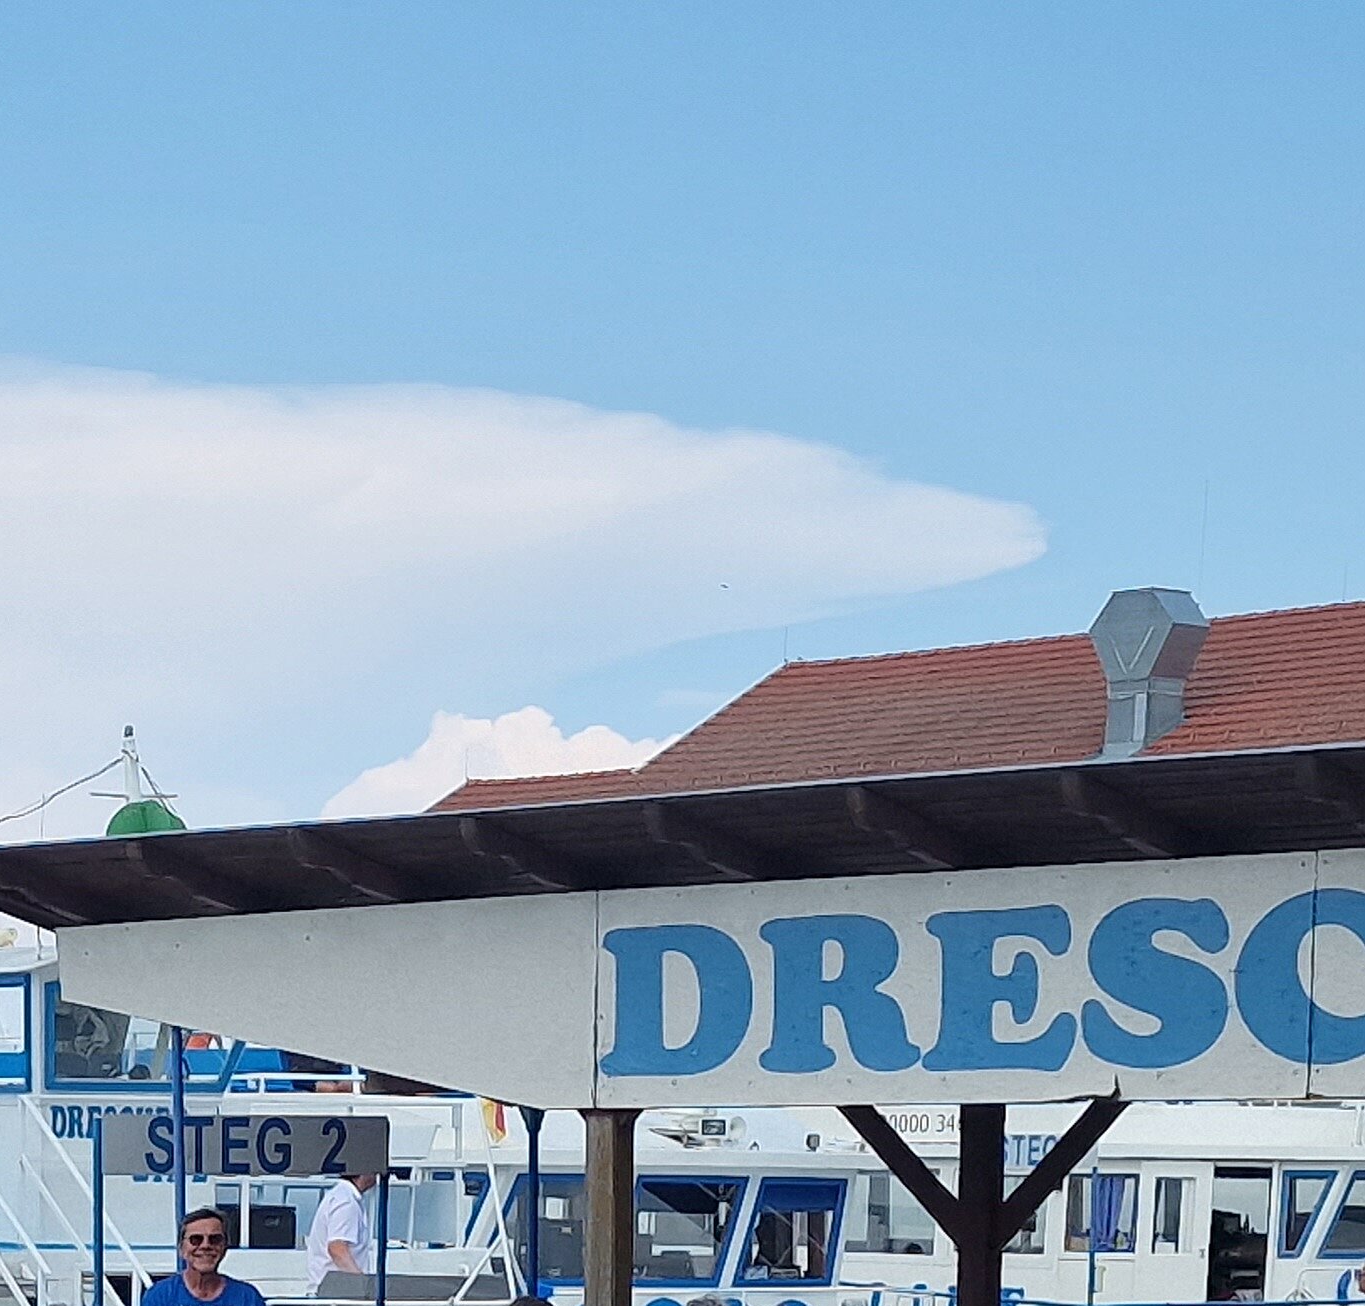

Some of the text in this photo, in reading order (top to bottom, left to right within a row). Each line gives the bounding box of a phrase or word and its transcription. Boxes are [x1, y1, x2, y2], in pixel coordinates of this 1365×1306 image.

[598, 888, 1365, 1077] DRESC
[145, 1115, 292, 1174] STEG
[320, 1118, 347, 1174] 2
[883, 1114, 961, 1133] 0000 34
[1004, 1134, 1058, 1166] TE
